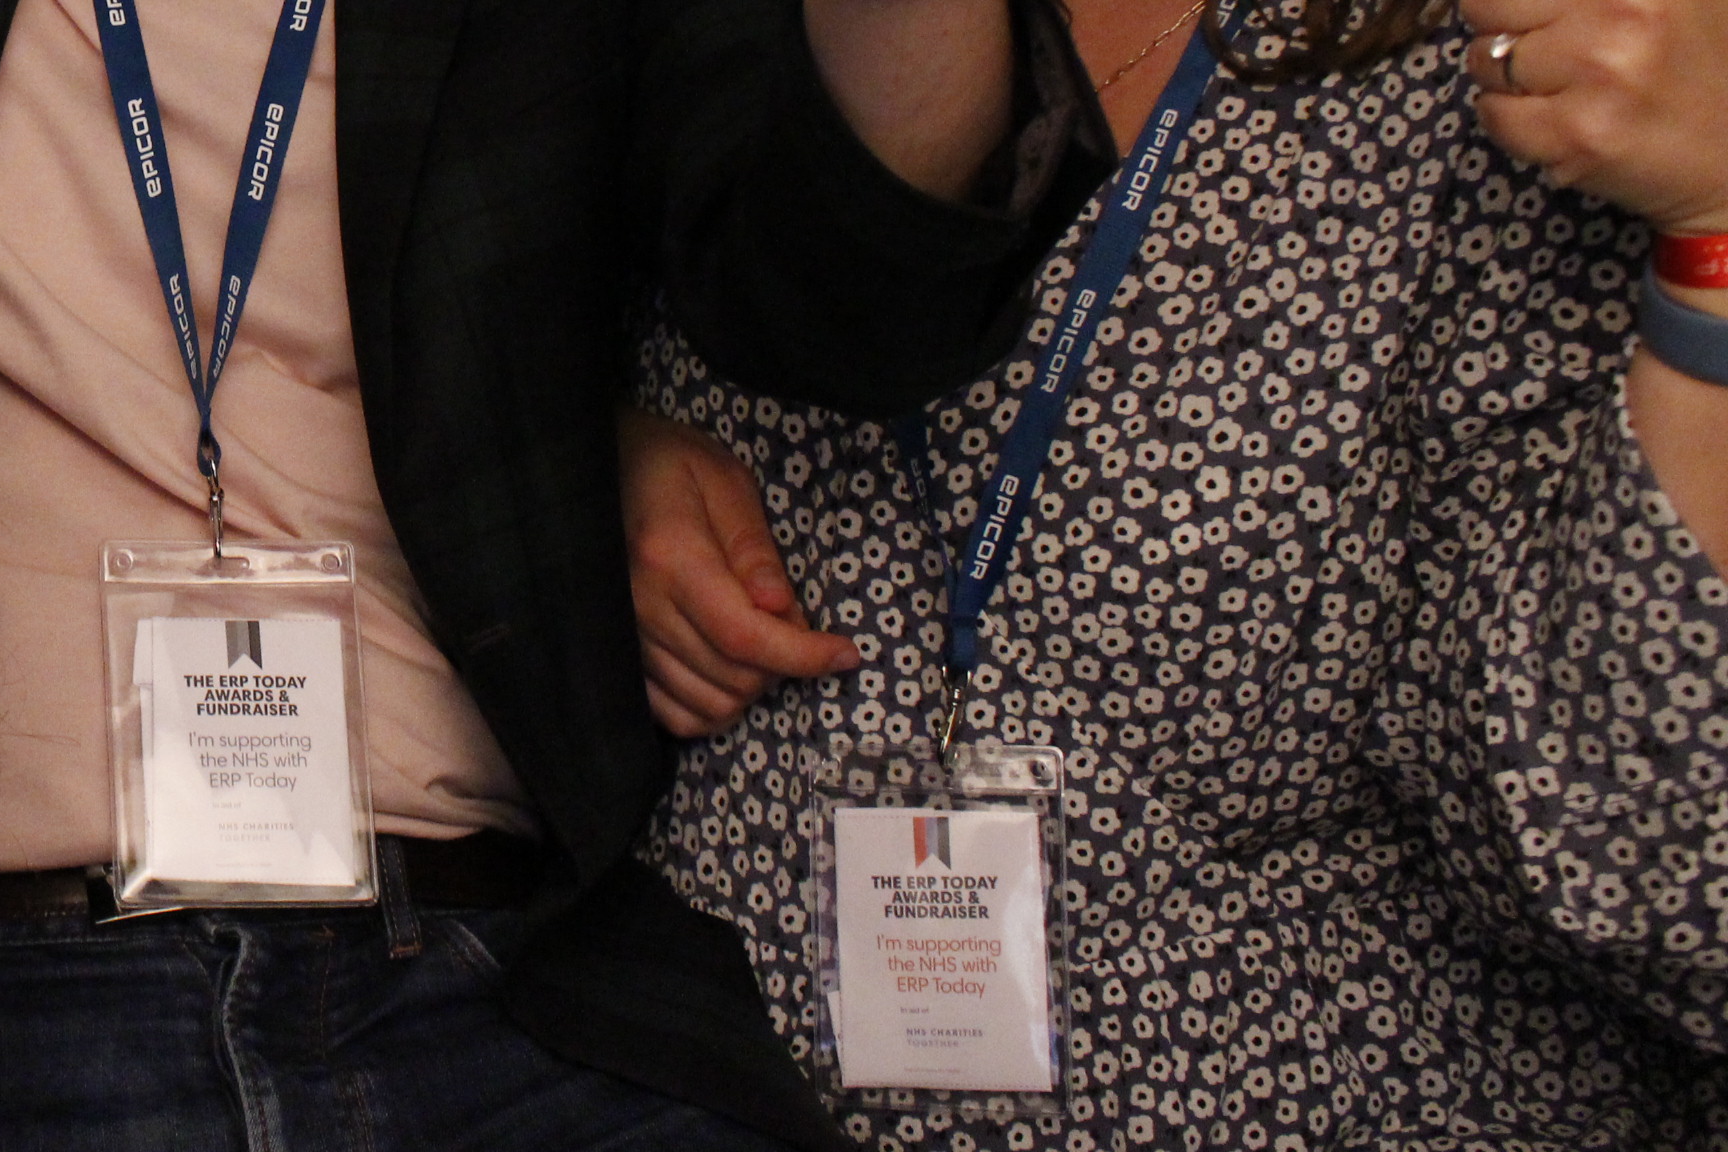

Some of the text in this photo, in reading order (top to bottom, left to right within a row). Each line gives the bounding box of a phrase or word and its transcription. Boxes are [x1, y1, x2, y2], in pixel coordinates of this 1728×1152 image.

[184, 675, 307, 689] THE ERP TODAY
[204, 689, 290, 703] AWARDS &
[196, 703, 299, 717] FUNDRAISER
[189, 731, 312, 752] I'm supporting
[200, 752, 308, 769] the NHS with
[209, 772, 297, 793] ERP Today
[871, 875, 998, 890] THE ERP TODAY
[892, 891, 980, 904] AWARDS &
[884, 905, 989, 919] FUNDRAISER
[877, 934, 1002, 957] I'm supporting
[888, 955, 998, 973] the NHS with
[897, 976, 986, 999] ERP Today
